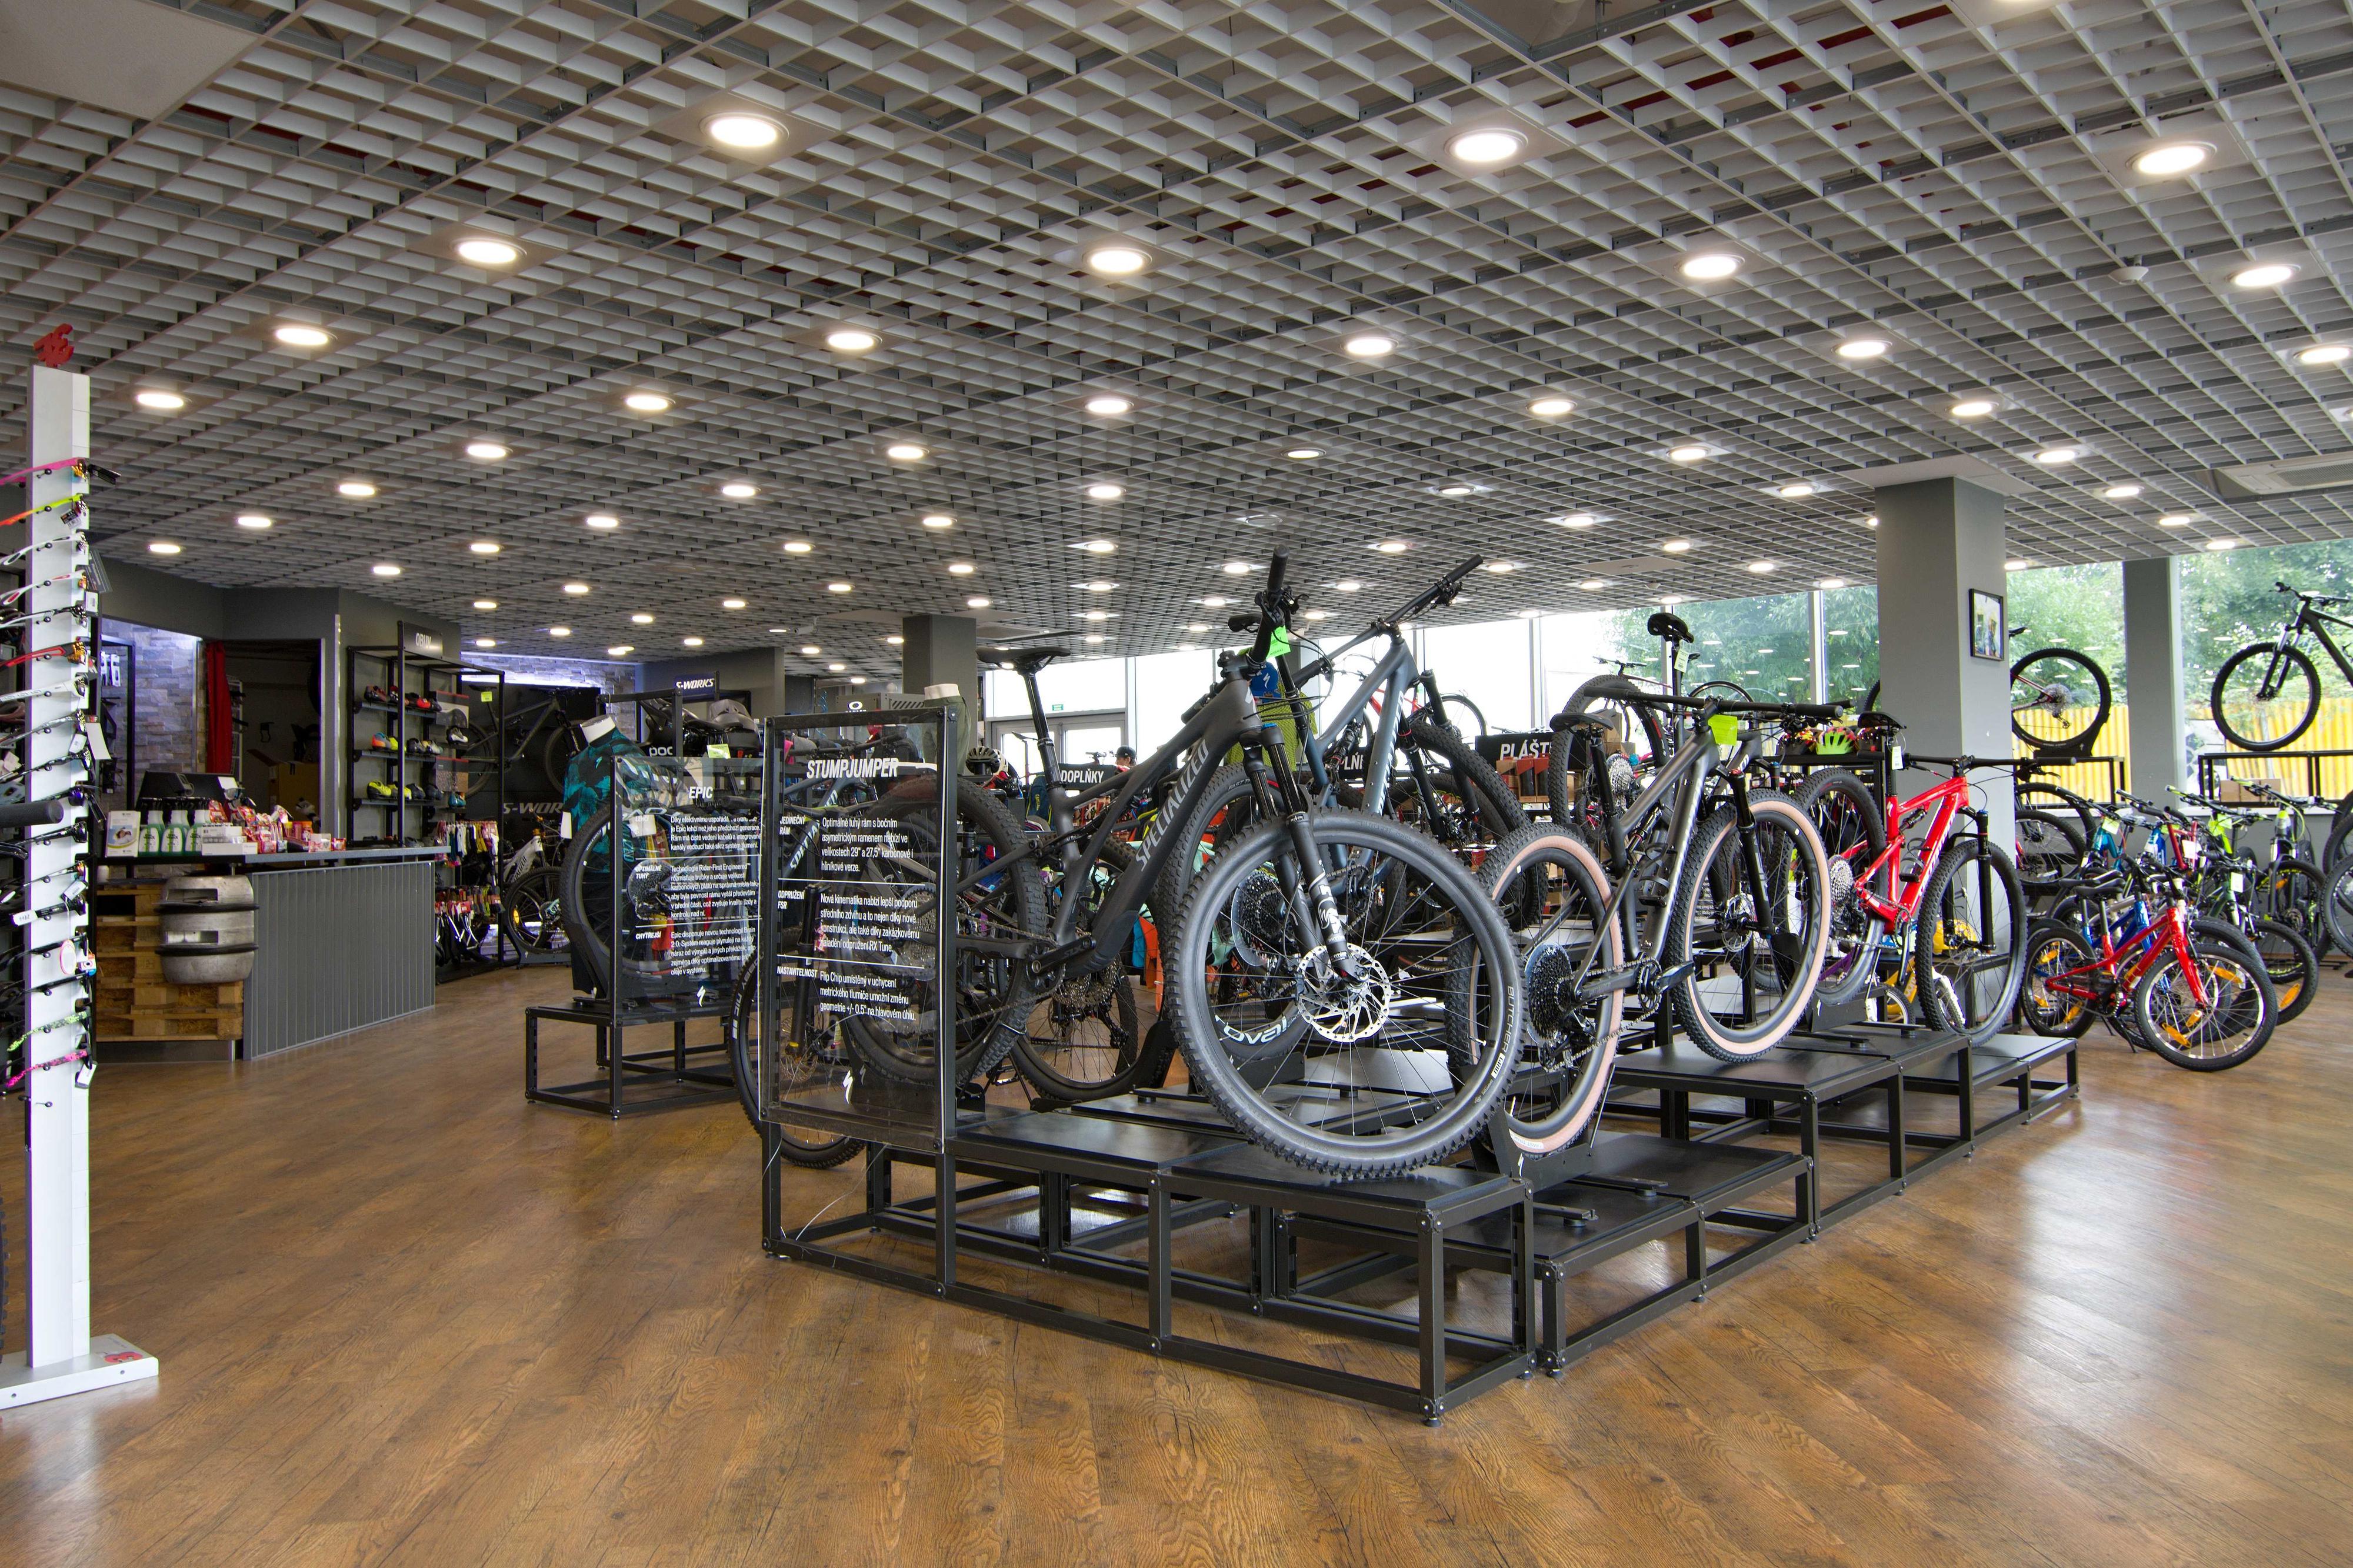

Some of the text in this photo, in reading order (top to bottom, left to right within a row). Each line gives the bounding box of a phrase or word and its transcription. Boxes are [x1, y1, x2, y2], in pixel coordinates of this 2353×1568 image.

[416, 633, 431, 646] OBUV
[676, 678, 715, 689] S-WORKS
[1500, 739, 1552, 760] PLÁŠT
[806, 758, 899, 779] STUMPJUMPER
[1061, 769, 1104, 783] DOPLŇKY
[688, 786, 714, 799] EPIC
[504, 802, 564, 814] S-WOR
[1135, 739, 1209, 872] SPECIALIZED
[779, 815, 805, 825] JEDINEČNÝ
[822, 817, 848, 828] Optimálně
[849, 818, 859, 829] tuhý
[861, 818, 872, 828] rám
[877, 817, 897, 828] bočním
[779, 826, 790, 835] RÁM
[822, 833, 856, 844] asymetrickým
[884, 833, 900, 843] nabízí
[822, 846, 849, 857] velikostech
[881, 848, 911, 859] karbonové
[821, 860, 860, 872] hliníkové verze.
[778, 889, 805, 900] ODPRUŽENÍ
[821, 893, 918, 909] Nová kinematika nabízí lepší podporu
[777, 901, 787, 909] FSR
[820, 908, 844, 919] středního
[845, 909, 862, 920] zdvihu
[867, 912, 873, 921] to
[874, 912, 889, 923] nejen
[890, 913, 901, 925] díky
[902, 913, 916, 923] nové
[821, 922, 848, 935] konstrukci,
[858, 925, 869, 935] také
[870, 925, 882, 938] díky
[882, 926, 919, 939] zakázkovému
[878, 941, 893, 952] Tune.
[776, 966, 818, 978] NASTAVITELNOST
[820, 970, 829, 983] Flip
[830, 972, 842, 984] Chip
[843, 974, 866, 987] umístěný
[872, 976, 896, 989] uchycení
[820, 987, 909, 1005] metrického tlumiče umožní změnu
[820, 1002, 846, 1013] geometrie
[867, 1007, 875, 1016] na
[875, 1006, 902, 1019] hlavovém
[902, 1007, 916, 1021] úhlu.
[1503, 986, 1514, 1053] BUTCHER
